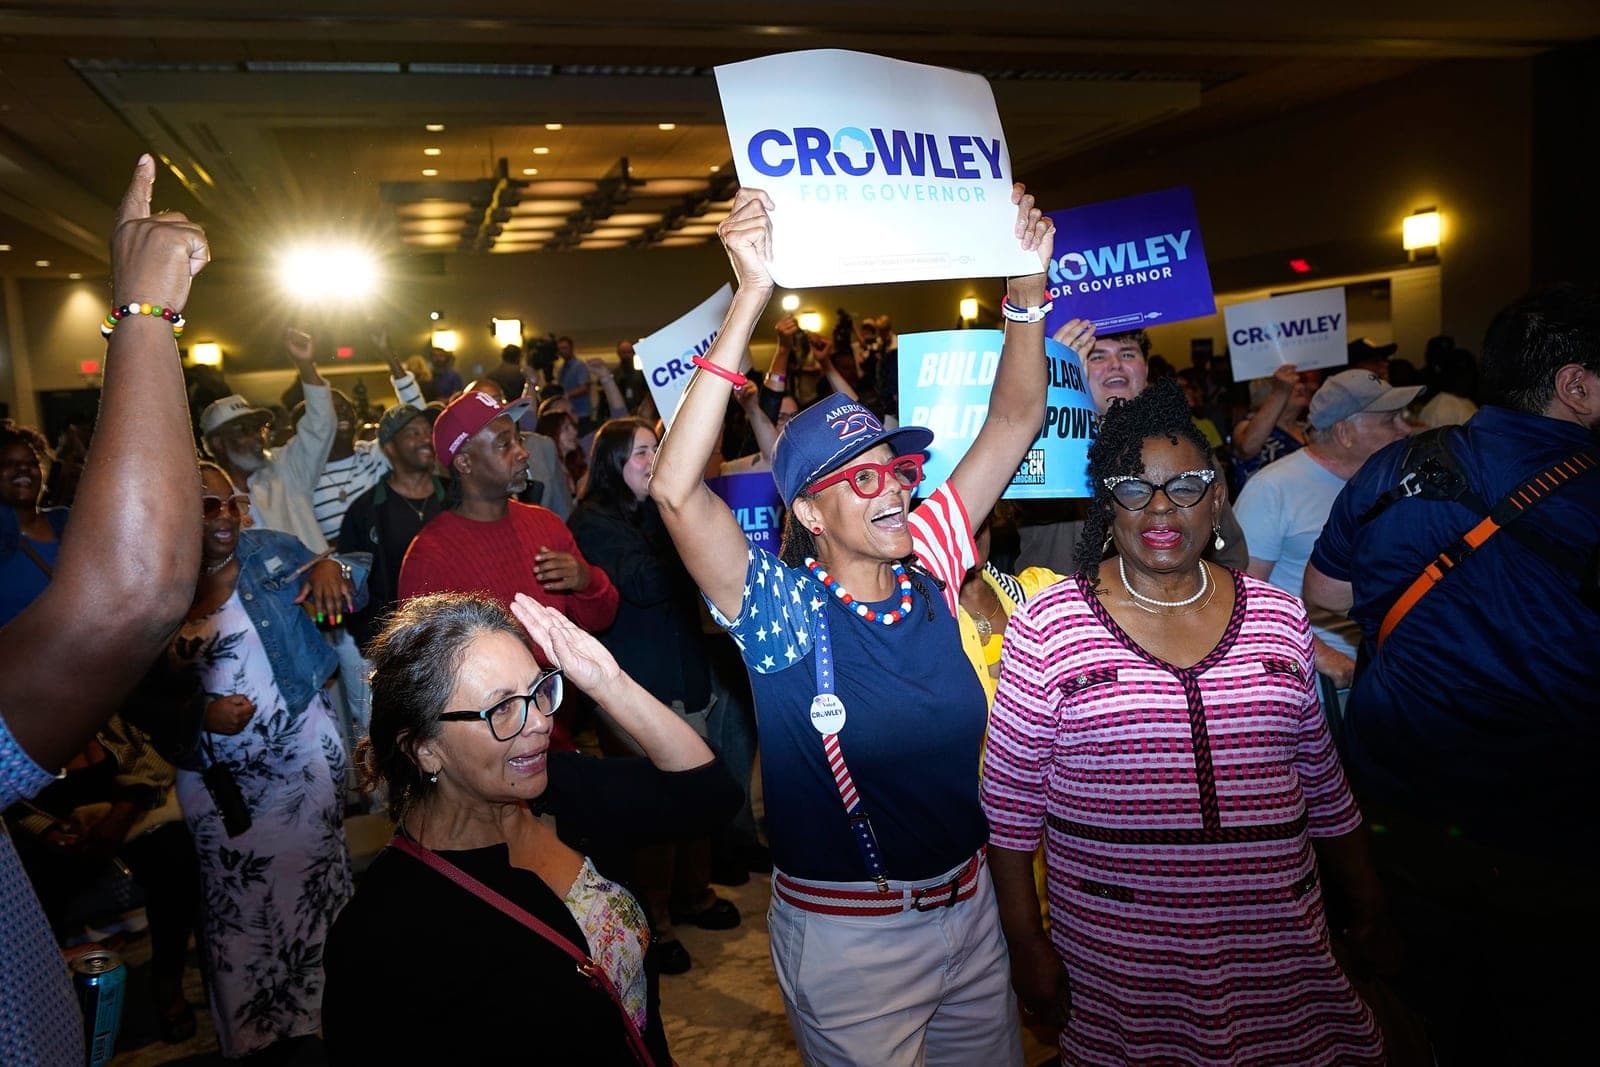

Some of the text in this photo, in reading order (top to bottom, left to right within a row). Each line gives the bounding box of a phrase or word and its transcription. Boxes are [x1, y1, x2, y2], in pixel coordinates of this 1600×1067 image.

[747, 126, 1003, 180] CROWLEY
[801, 184, 987, 203] FOR GOVERNOR
[1048, 229, 1191, 284] ROWLEY
[1050, 266, 1172, 298] OR GOVERNOR
[1232, 313, 1341, 346] CROWLEY
[917, 351, 998, 387] BUILD
[912, 404, 1098, 440] POLIT POWE
[812, 709, 842, 718] CROWLEY
